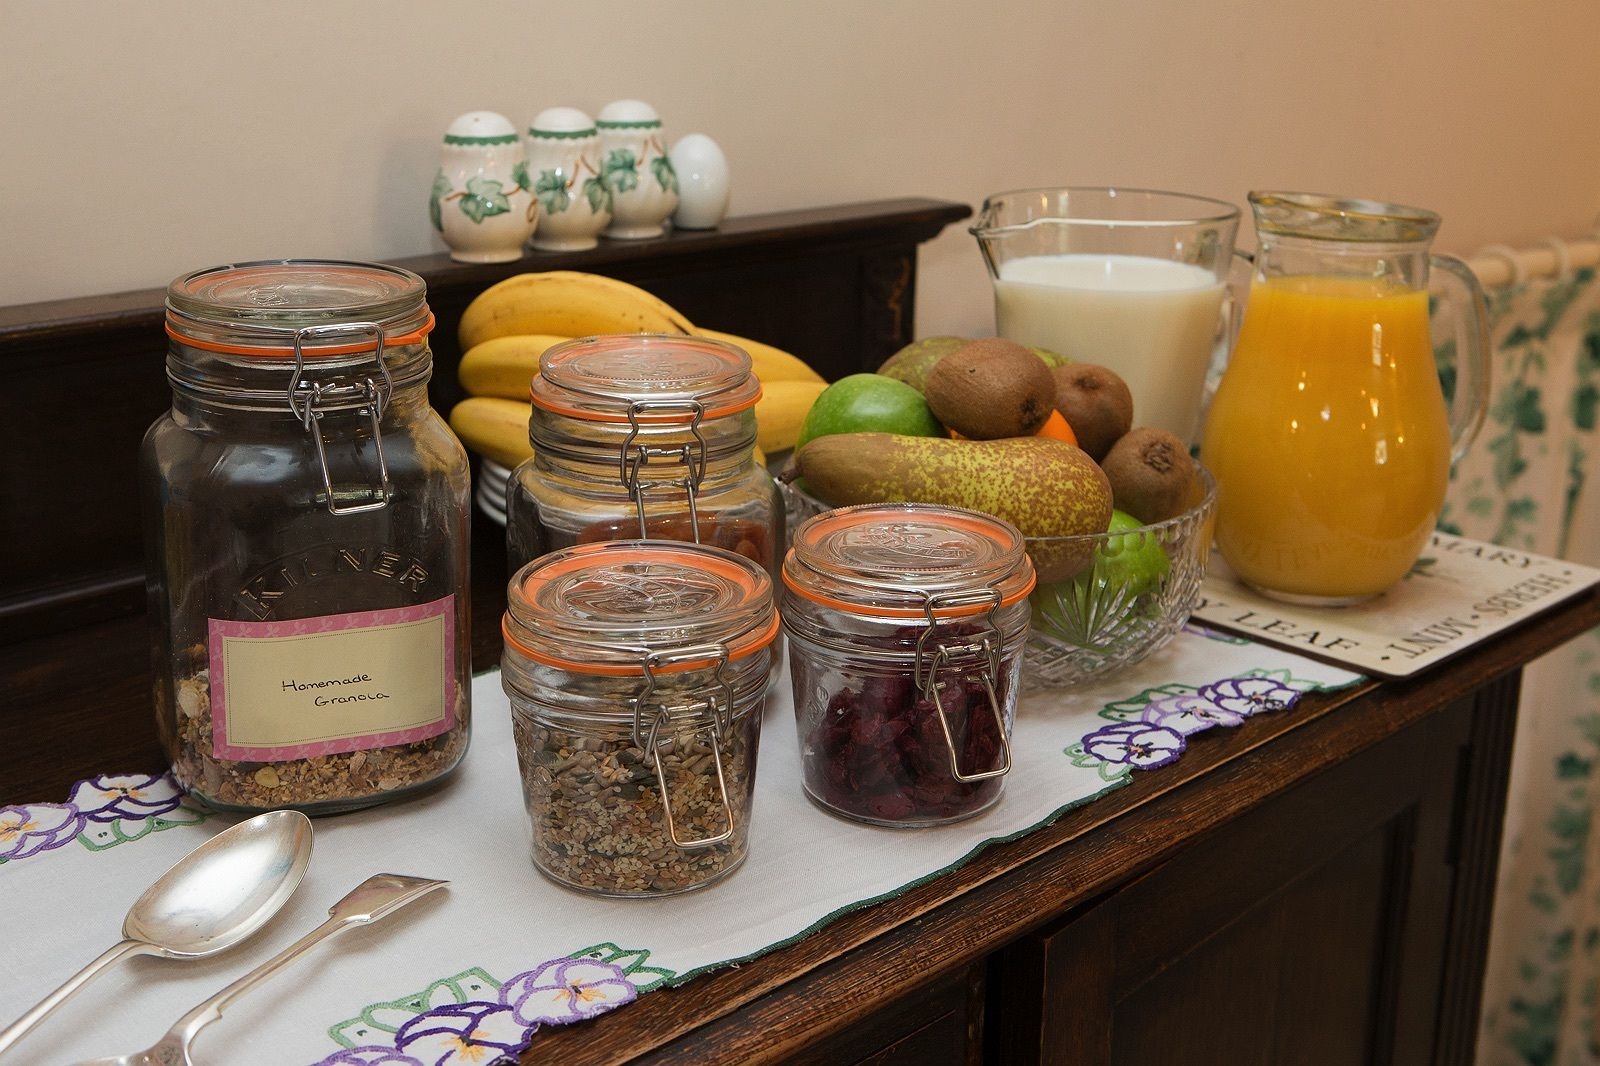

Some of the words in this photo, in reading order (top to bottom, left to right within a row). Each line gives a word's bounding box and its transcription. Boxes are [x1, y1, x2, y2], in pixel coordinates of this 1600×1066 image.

[238, 547, 430, 620] KILNER
[1233, 611, 1361, 651] LEAF
[1388, 616, 1479, 660] MINT
[281, 673, 373, 692] Homemade
